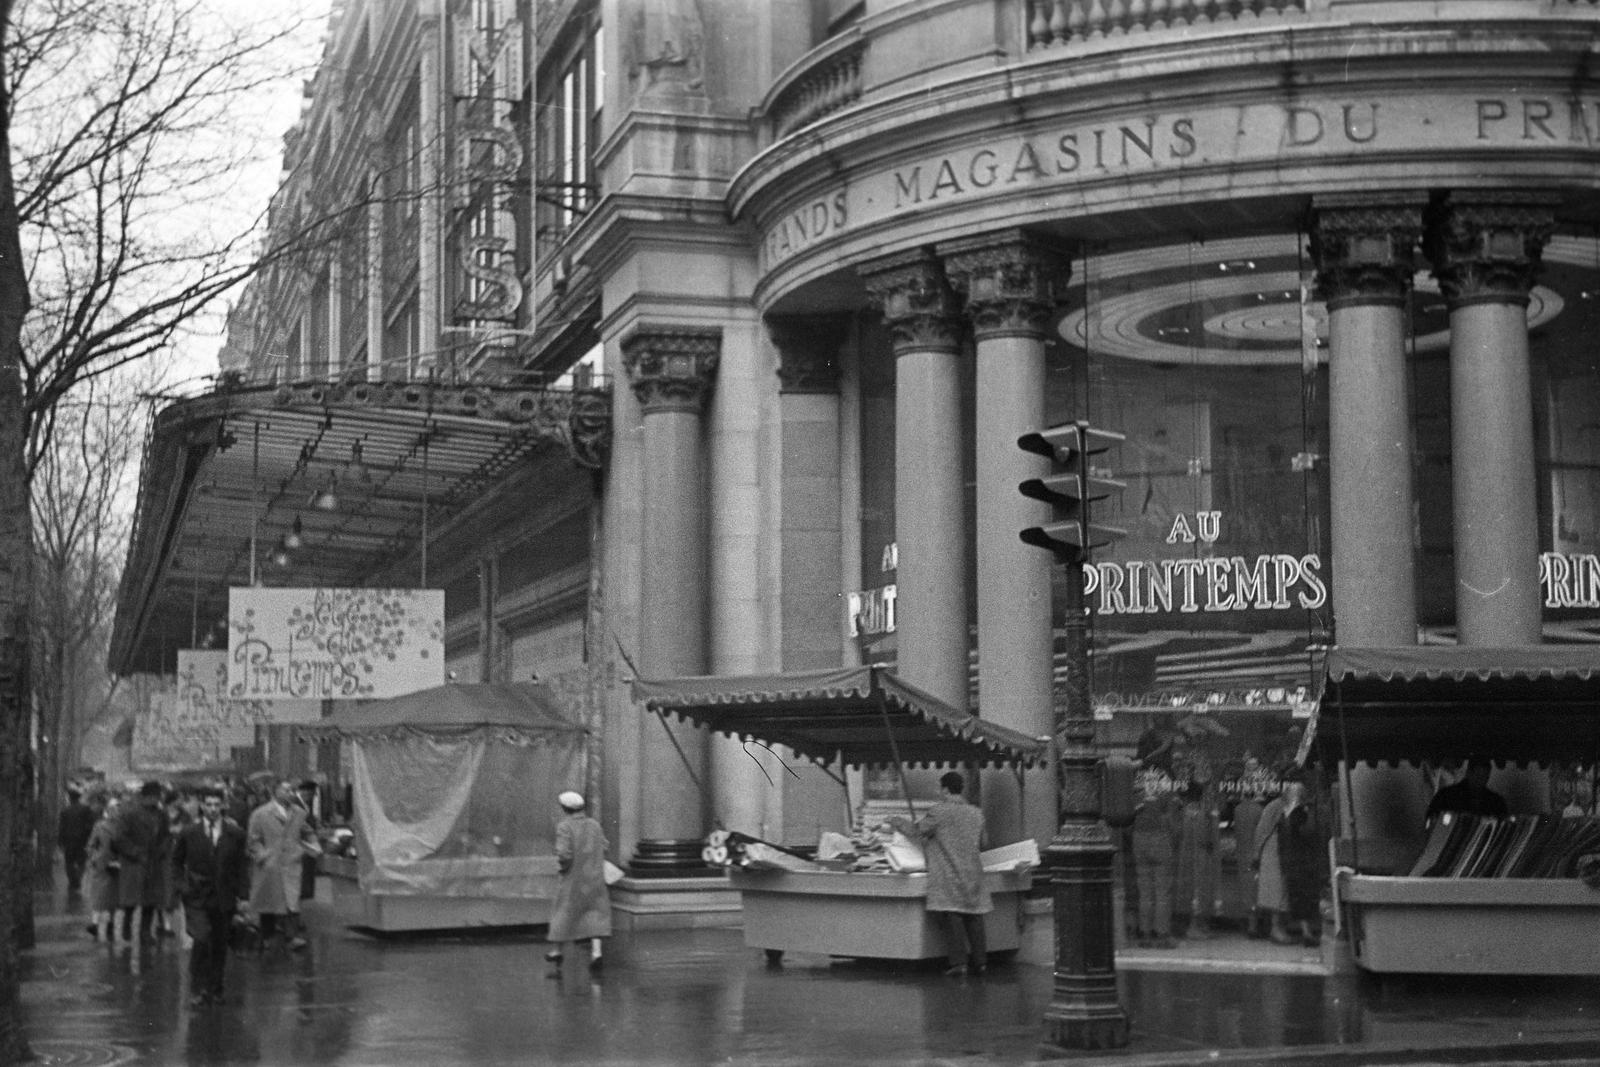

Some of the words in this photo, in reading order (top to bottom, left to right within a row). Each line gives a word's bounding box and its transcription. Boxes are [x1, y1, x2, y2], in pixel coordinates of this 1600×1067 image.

[894, 118, 1198, 209] MAGASINS
[1286, 103, 1381, 146] DU
[1476, 99, 1600, 141] PRI
[1166, 510, 1222, 544] AU
[1083, 553, 1328, 615] PRINTEMPS
